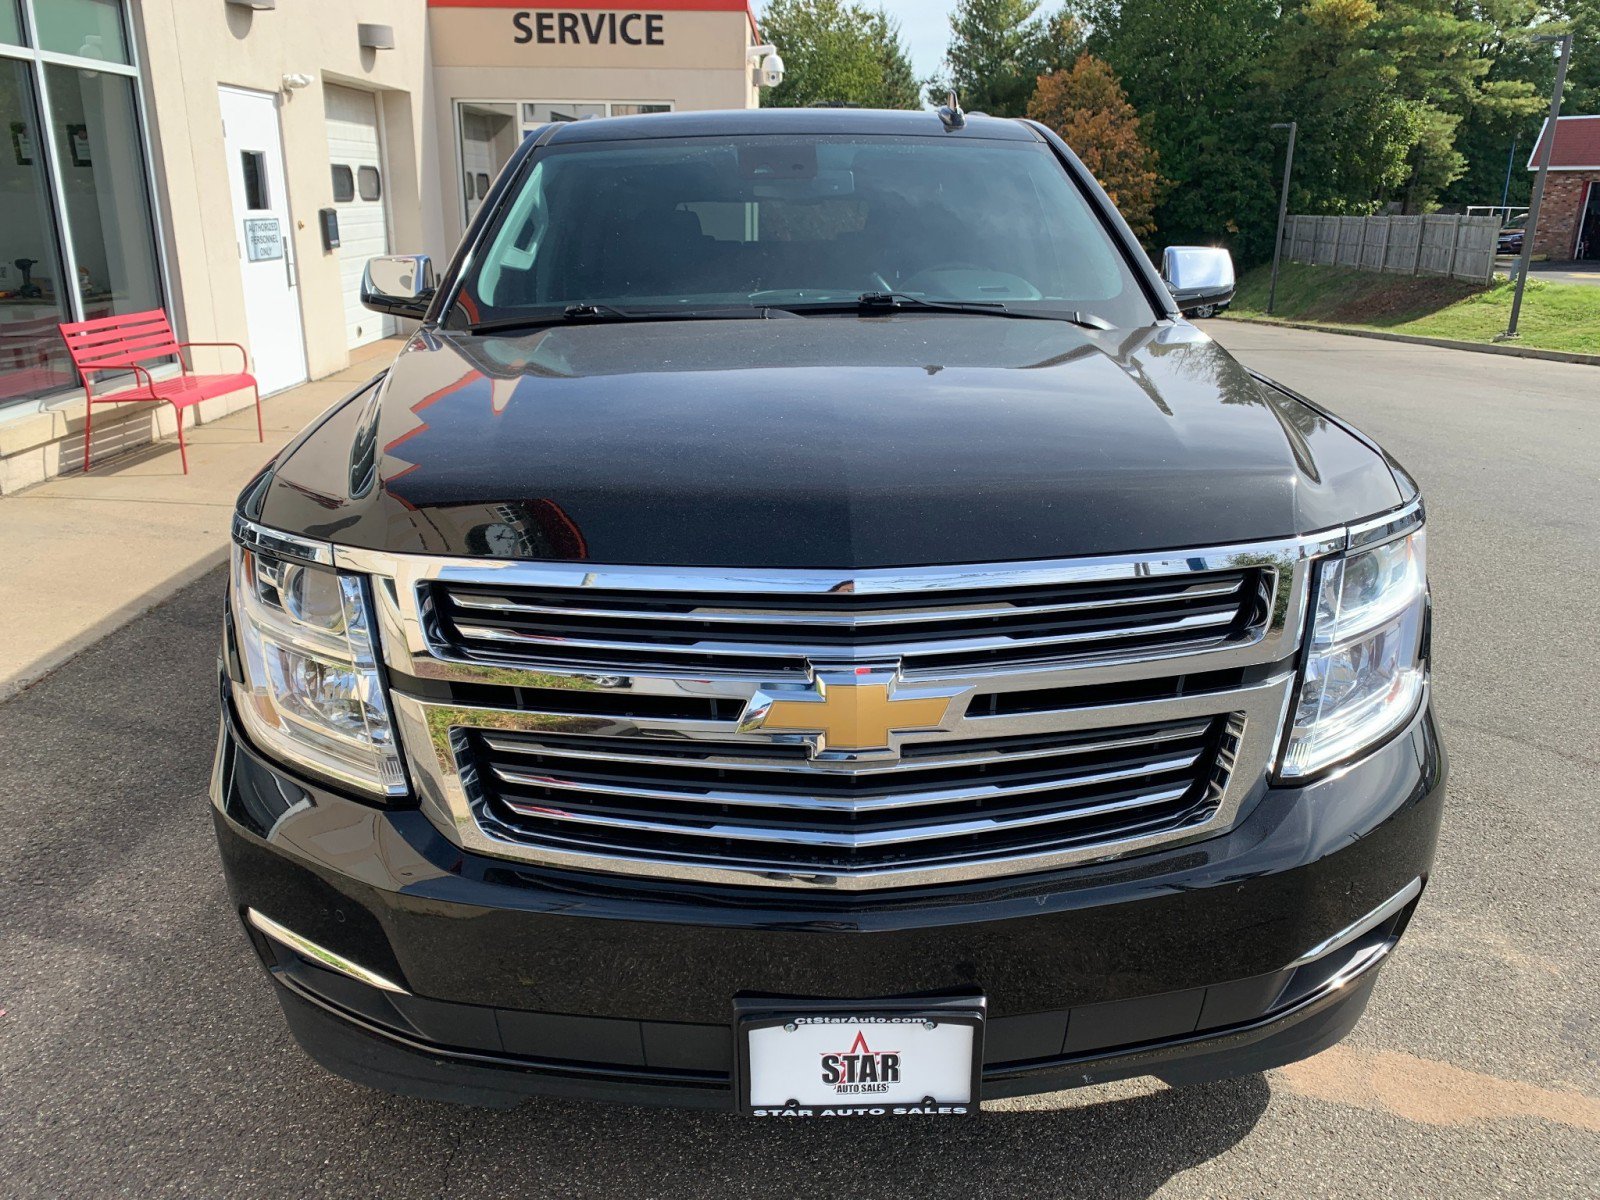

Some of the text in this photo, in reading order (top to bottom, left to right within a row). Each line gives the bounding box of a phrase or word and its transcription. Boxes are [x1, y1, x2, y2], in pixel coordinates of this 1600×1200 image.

[513, 11, 664, 45] SERVICE
[260, 247, 272, 256] ONLY
[794, 1016, 928, 1025] CtStarAuto.com
[821, 1054, 900, 1084] STAR
[836, 1083, 887, 1093] AUTO SALES
[753, 1107, 968, 1117] STAR AUTO SALES
